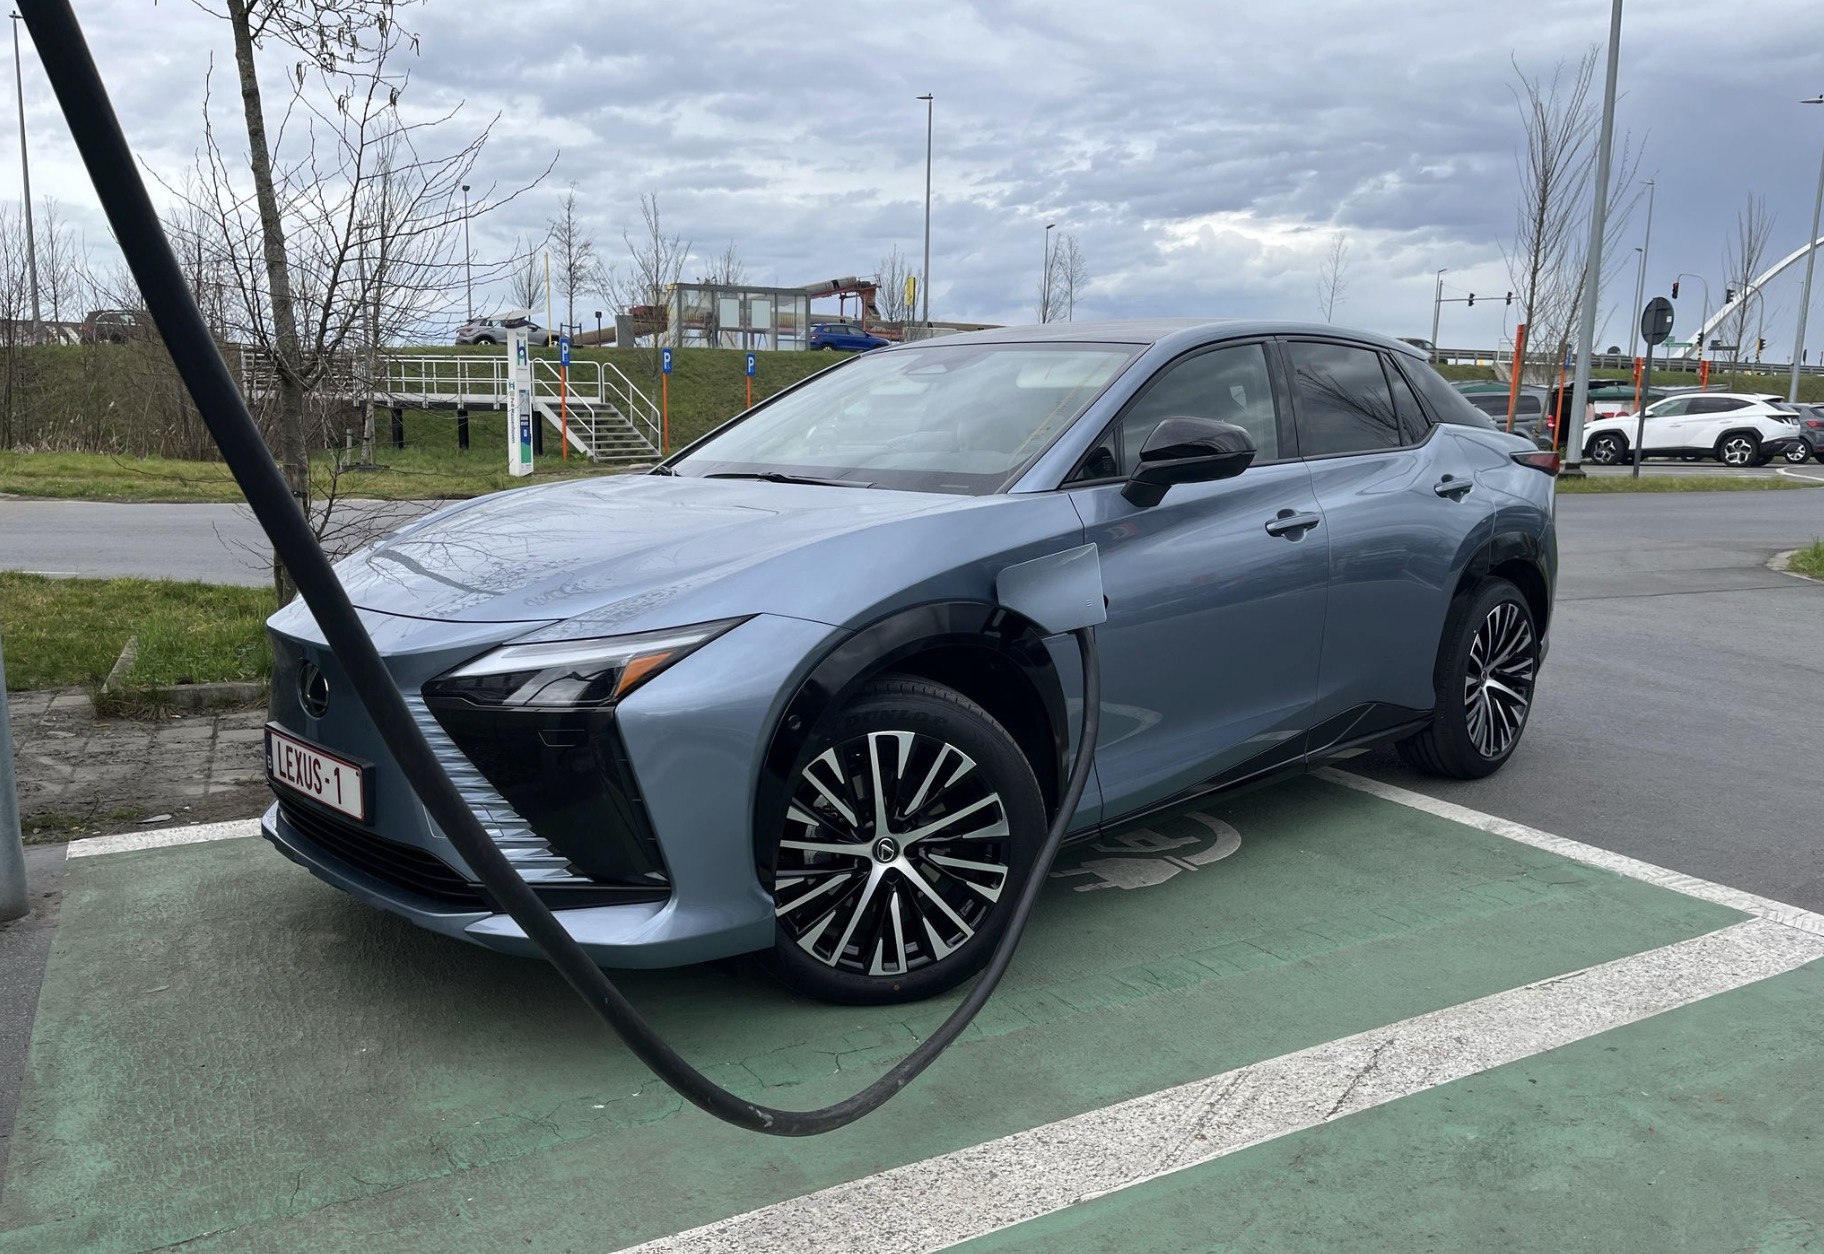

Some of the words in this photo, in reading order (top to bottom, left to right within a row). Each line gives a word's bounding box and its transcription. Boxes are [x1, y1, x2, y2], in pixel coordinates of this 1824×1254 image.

[562, 342, 569, 362] P
[664, 352, 671, 370] P
[748, 356, 755, 373] P
[845, 709, 948, 727] DUNLOP
[267, 755, 273, 770] B
[277, 741, 342, 805] LEXUS-1
